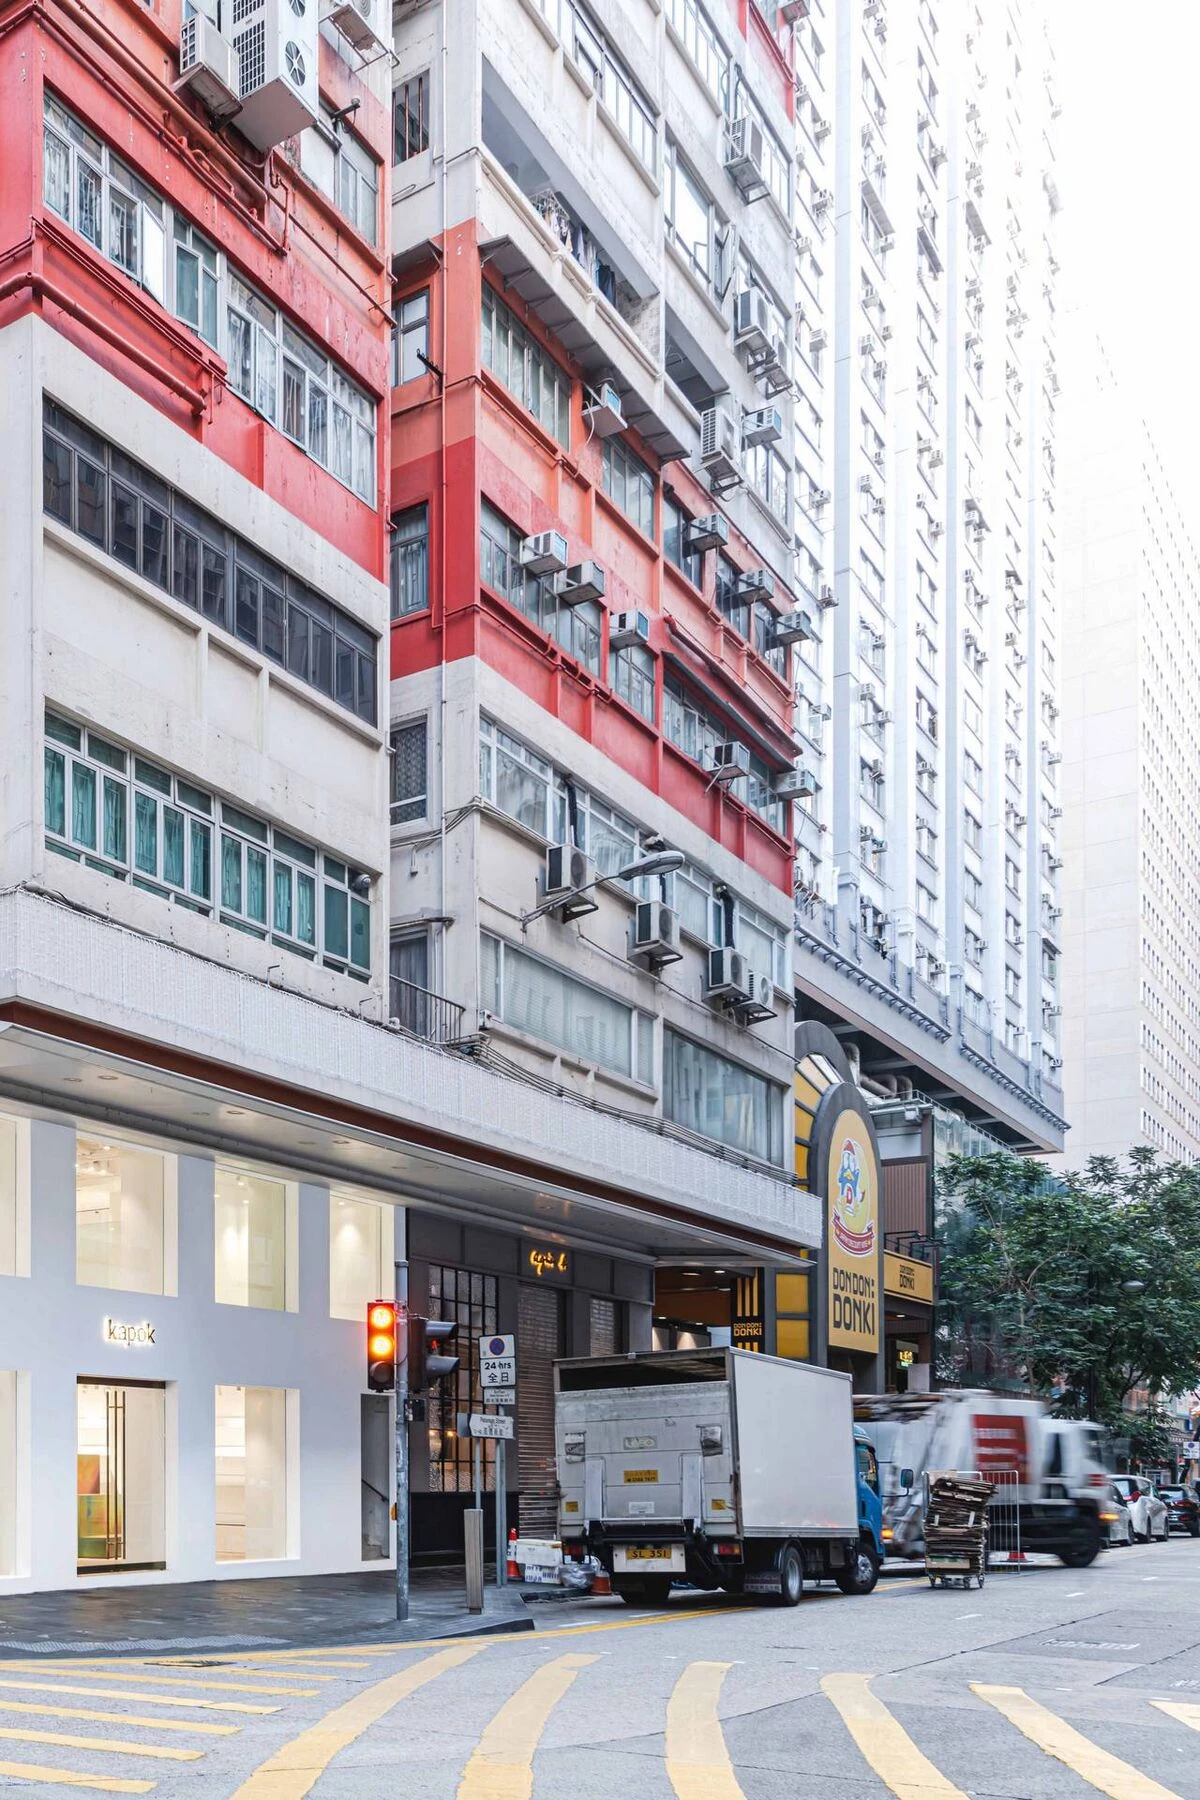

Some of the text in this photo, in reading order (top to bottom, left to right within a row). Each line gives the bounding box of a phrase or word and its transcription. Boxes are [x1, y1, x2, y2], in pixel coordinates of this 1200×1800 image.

[832, 1293, 875, 1336] DONKI
[108, 1318, 156, 1346] kapok
[733, 1328, 763, 1336] DONKI
[484, 1361, 512, 1370] 24 hrs
[487, 1371, 509, 1384] 全日
[631, 1550, 667, 1559] SL 351
